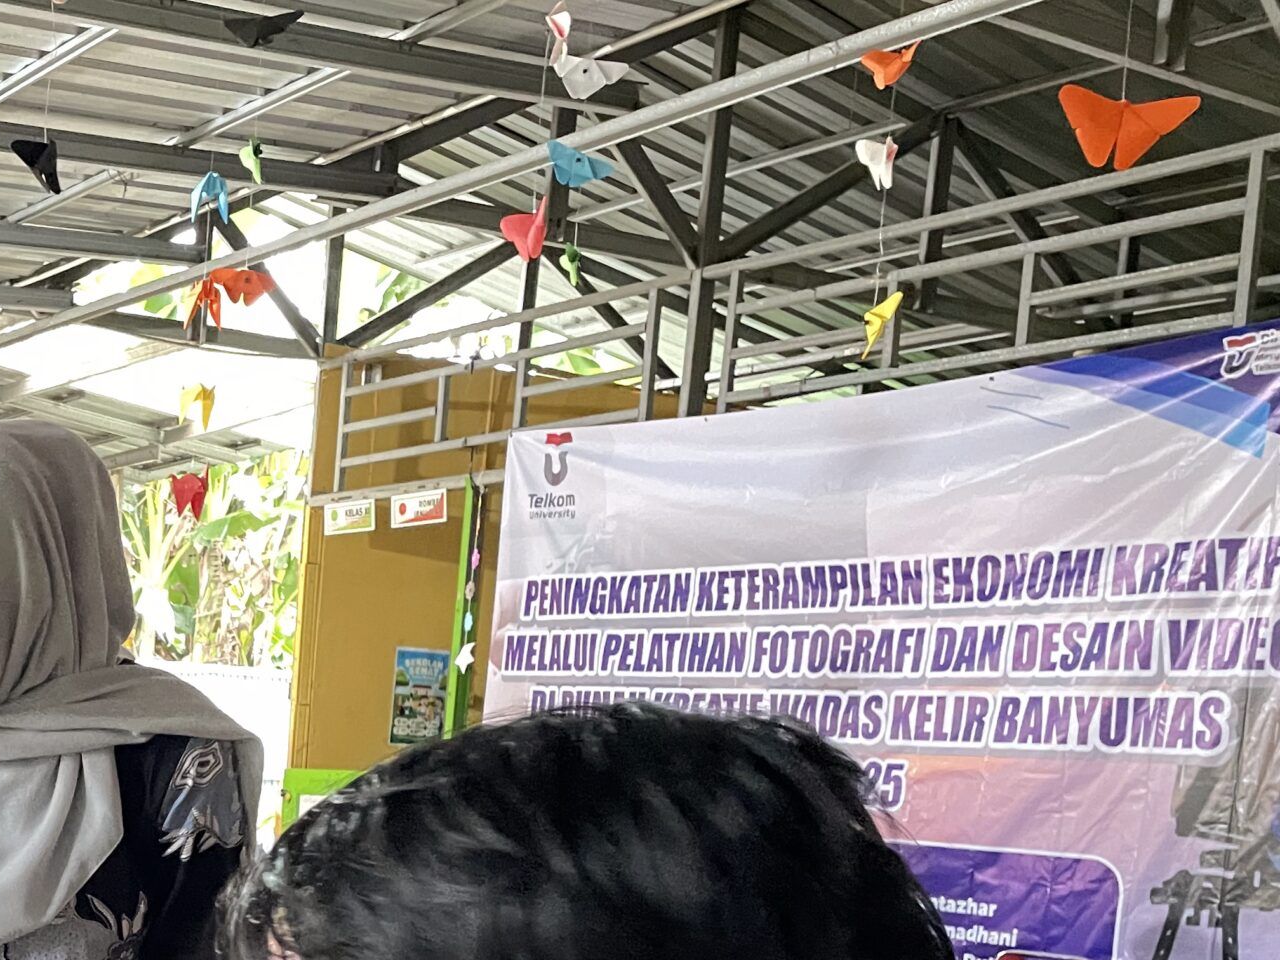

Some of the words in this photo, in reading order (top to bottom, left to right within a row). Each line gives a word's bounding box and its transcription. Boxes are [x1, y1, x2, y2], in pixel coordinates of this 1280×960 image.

[345, 506, 363, 518] KELAS
[528, 492, 576, 509] Telkom
[529, 508, 576, 519] University
[523, 572, 692, 616] PENINGKATAN
[695, 560, 923, 611] KETERAMPILAN
[932, 548, 1105, 604] EKONOMI
[1110, 536, 1280, 596] KREATIF
[504, 633, 598, 672] MELALUI
[600, 631, 748, 672] PELATIHAN
[751, 627, 926, 673] FOTOGRAFI
[930, 625, 1007, 672] DAN
[1011, 620, 1154, 672] DESAIN
[889, 695, 990, 742] KELIR
[993, 696, 1225, 750] BANYUMAS
[864, 761, 905, 808] 25
[930, 896, 998, 917] tazhar
[944, 925, 1019, 948] adhani
